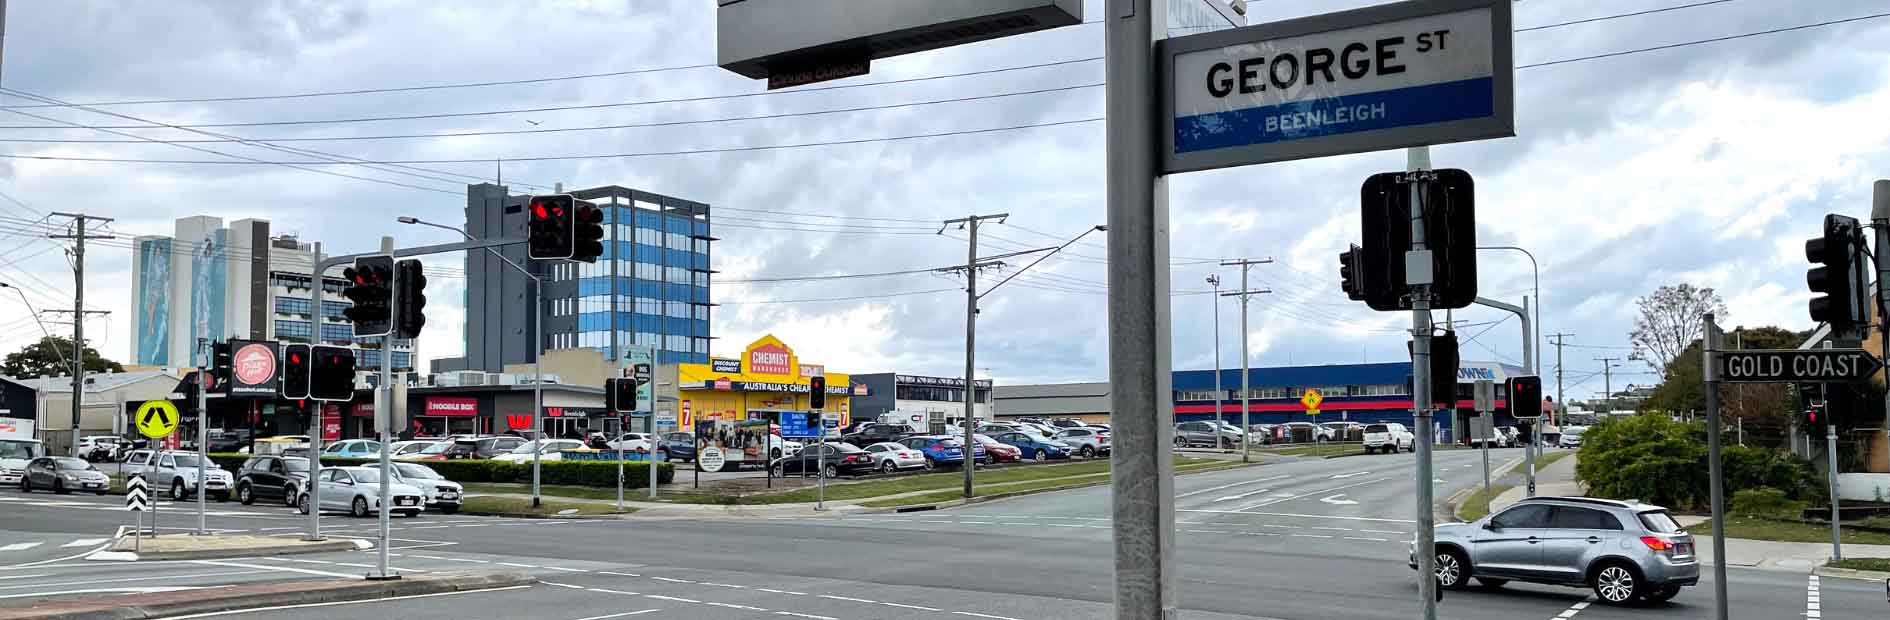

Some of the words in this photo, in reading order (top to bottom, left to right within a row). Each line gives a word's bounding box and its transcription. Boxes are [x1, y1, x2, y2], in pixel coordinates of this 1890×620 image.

[1206, 36, 1406, 98] GEORGE
[1416, 29, 1450, 53] ST
[1265, 101, 1386, 133] BEENLEIGH
[752, 351, 789, 367] CHEMIST
[1728, 354, 1783, 377] GOLD
[1793, 354, 1861, 377] COAST
[743, 382, 788, 392] AUSTRALIA'S
[683, 408, 690, 425] 7
[841, 411, 848, 425] 7
